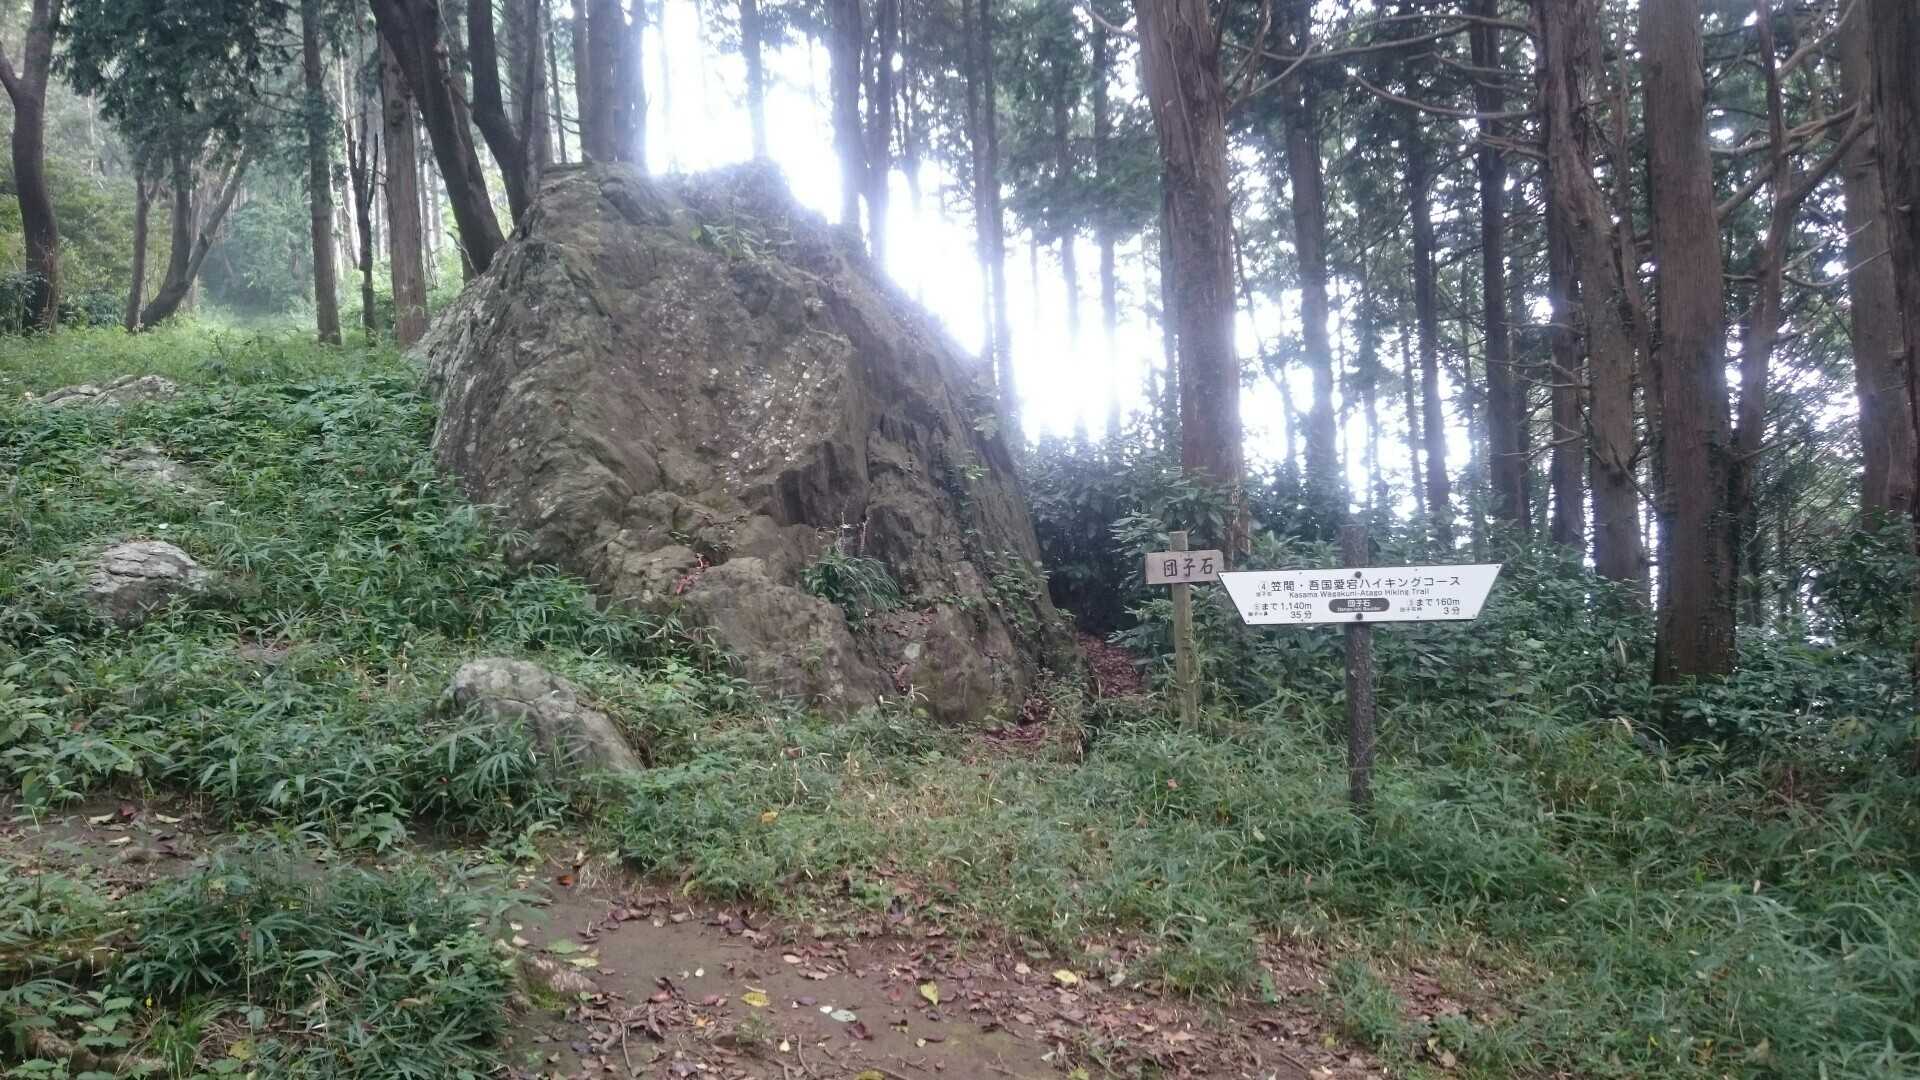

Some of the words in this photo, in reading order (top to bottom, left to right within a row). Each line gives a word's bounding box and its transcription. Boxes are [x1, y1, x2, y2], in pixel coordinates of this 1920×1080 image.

[1164, 557, 1213, 577] 団子石
[1271, 576, 1461, 591] 笠間・吾国愛宕ハイキングコース
[1289, 591, 1318, 599] Kasama
